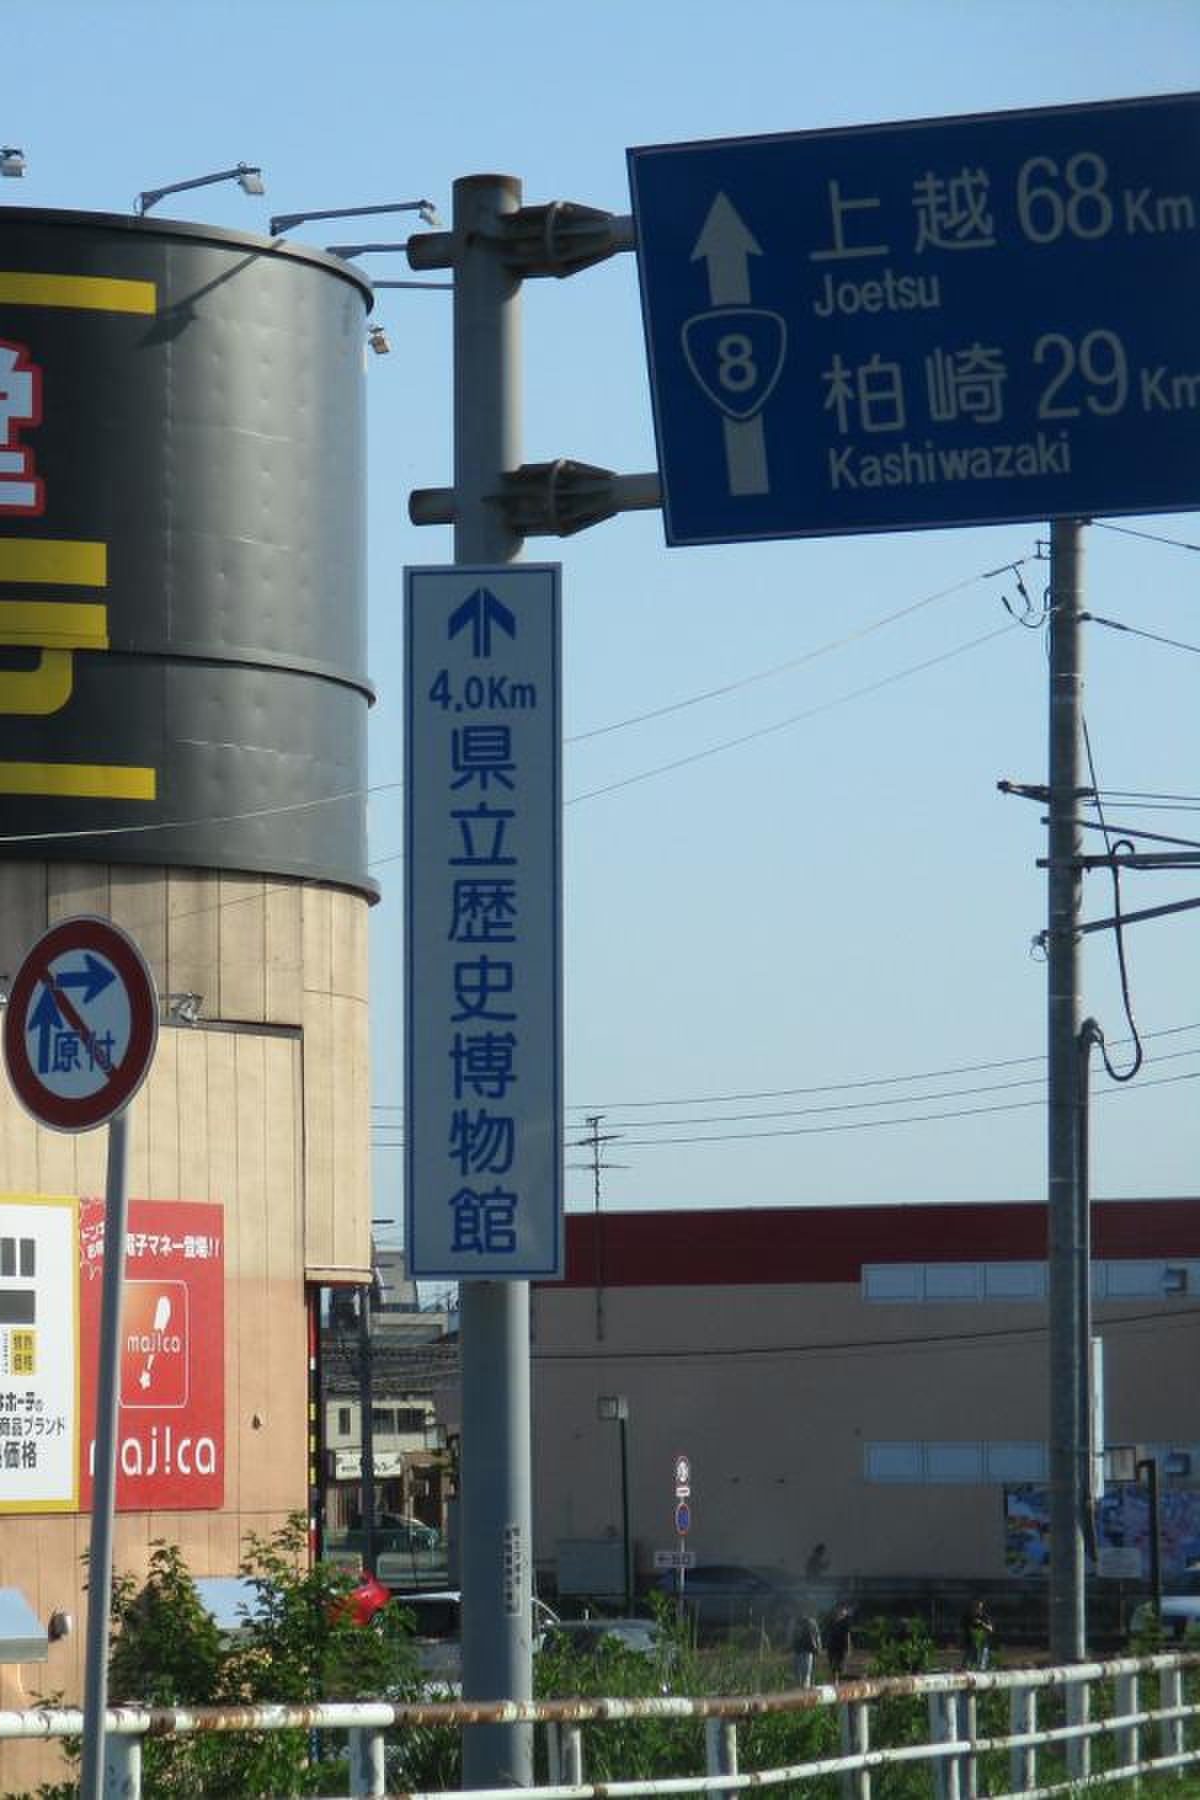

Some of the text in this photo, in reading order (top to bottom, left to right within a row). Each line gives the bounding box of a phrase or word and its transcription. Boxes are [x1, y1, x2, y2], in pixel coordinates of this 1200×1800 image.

[809, 152, 1196, 260] 上越 68 Km
[814, 267, 941, 317] Joetsu
[717, 333, 758, 392] 8
[822, 342, 1008, 434] 柏崎
[1033, 329, 1130, 419] 29
[829, 430, 1071, 490] Kashiwazaki
[429, 669, 536, 713] 4.0Km
[448, 724, 518, 1256] 県立歴史博物館
[52, 1029, 116, 1072] 原付
[89, 1426, 216, 1475] aj!ca
